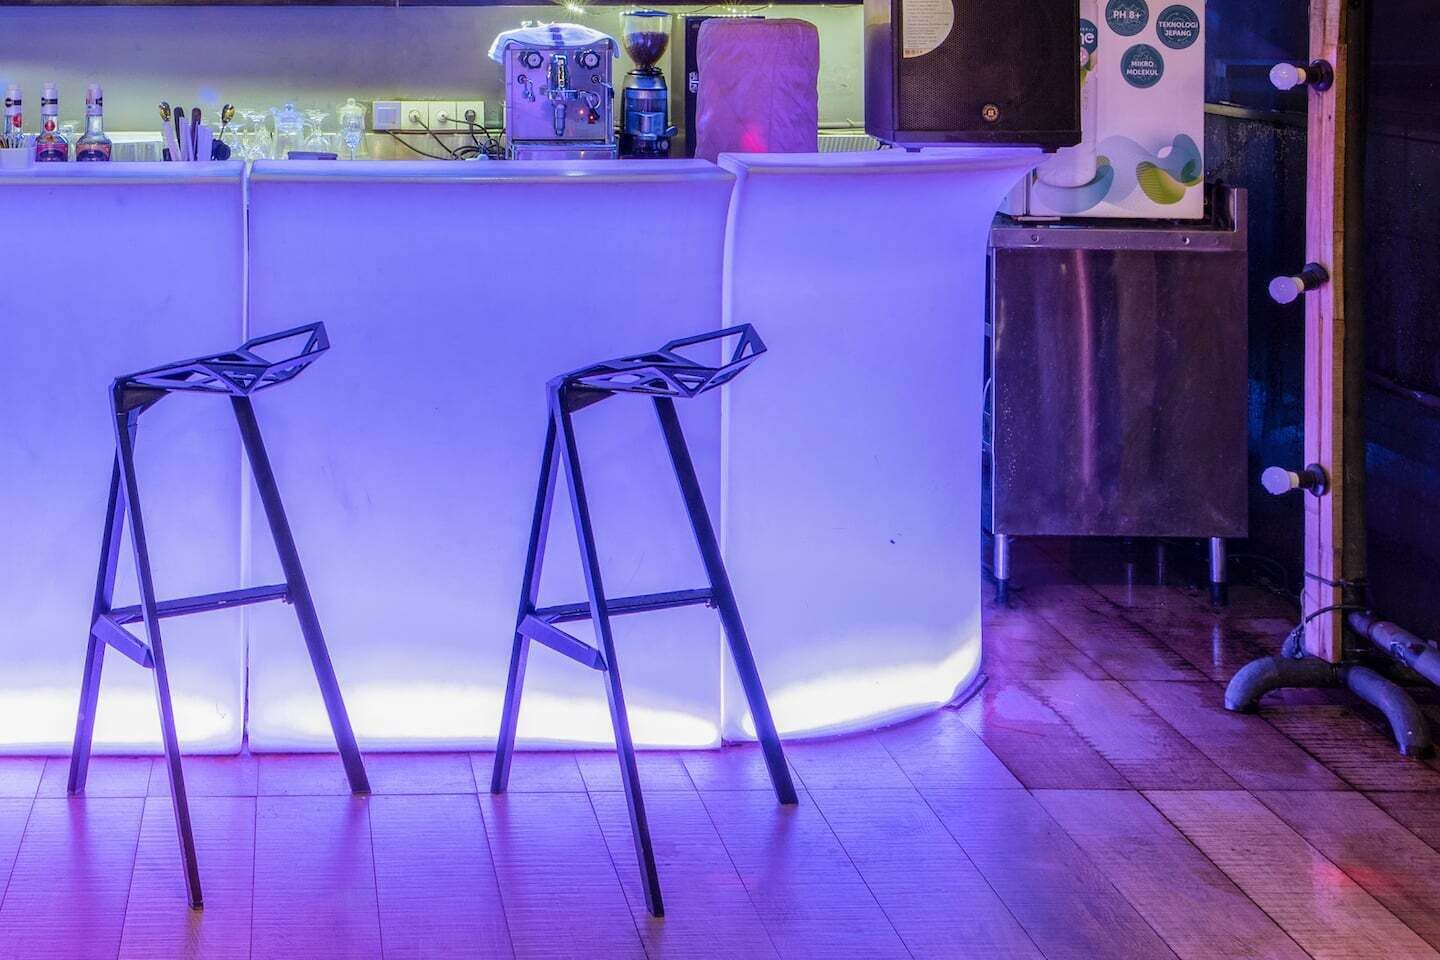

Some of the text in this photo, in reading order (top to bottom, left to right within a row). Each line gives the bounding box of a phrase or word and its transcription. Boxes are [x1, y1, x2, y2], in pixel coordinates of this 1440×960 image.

[1113, 10, 1141, 20] PH 8+
[1159, 20, 1199, 29] TEKNOLOGI
[1130, 60, 1154, 68] MIKRO
[1126, 68, 1159, 76] MOLEKUL
